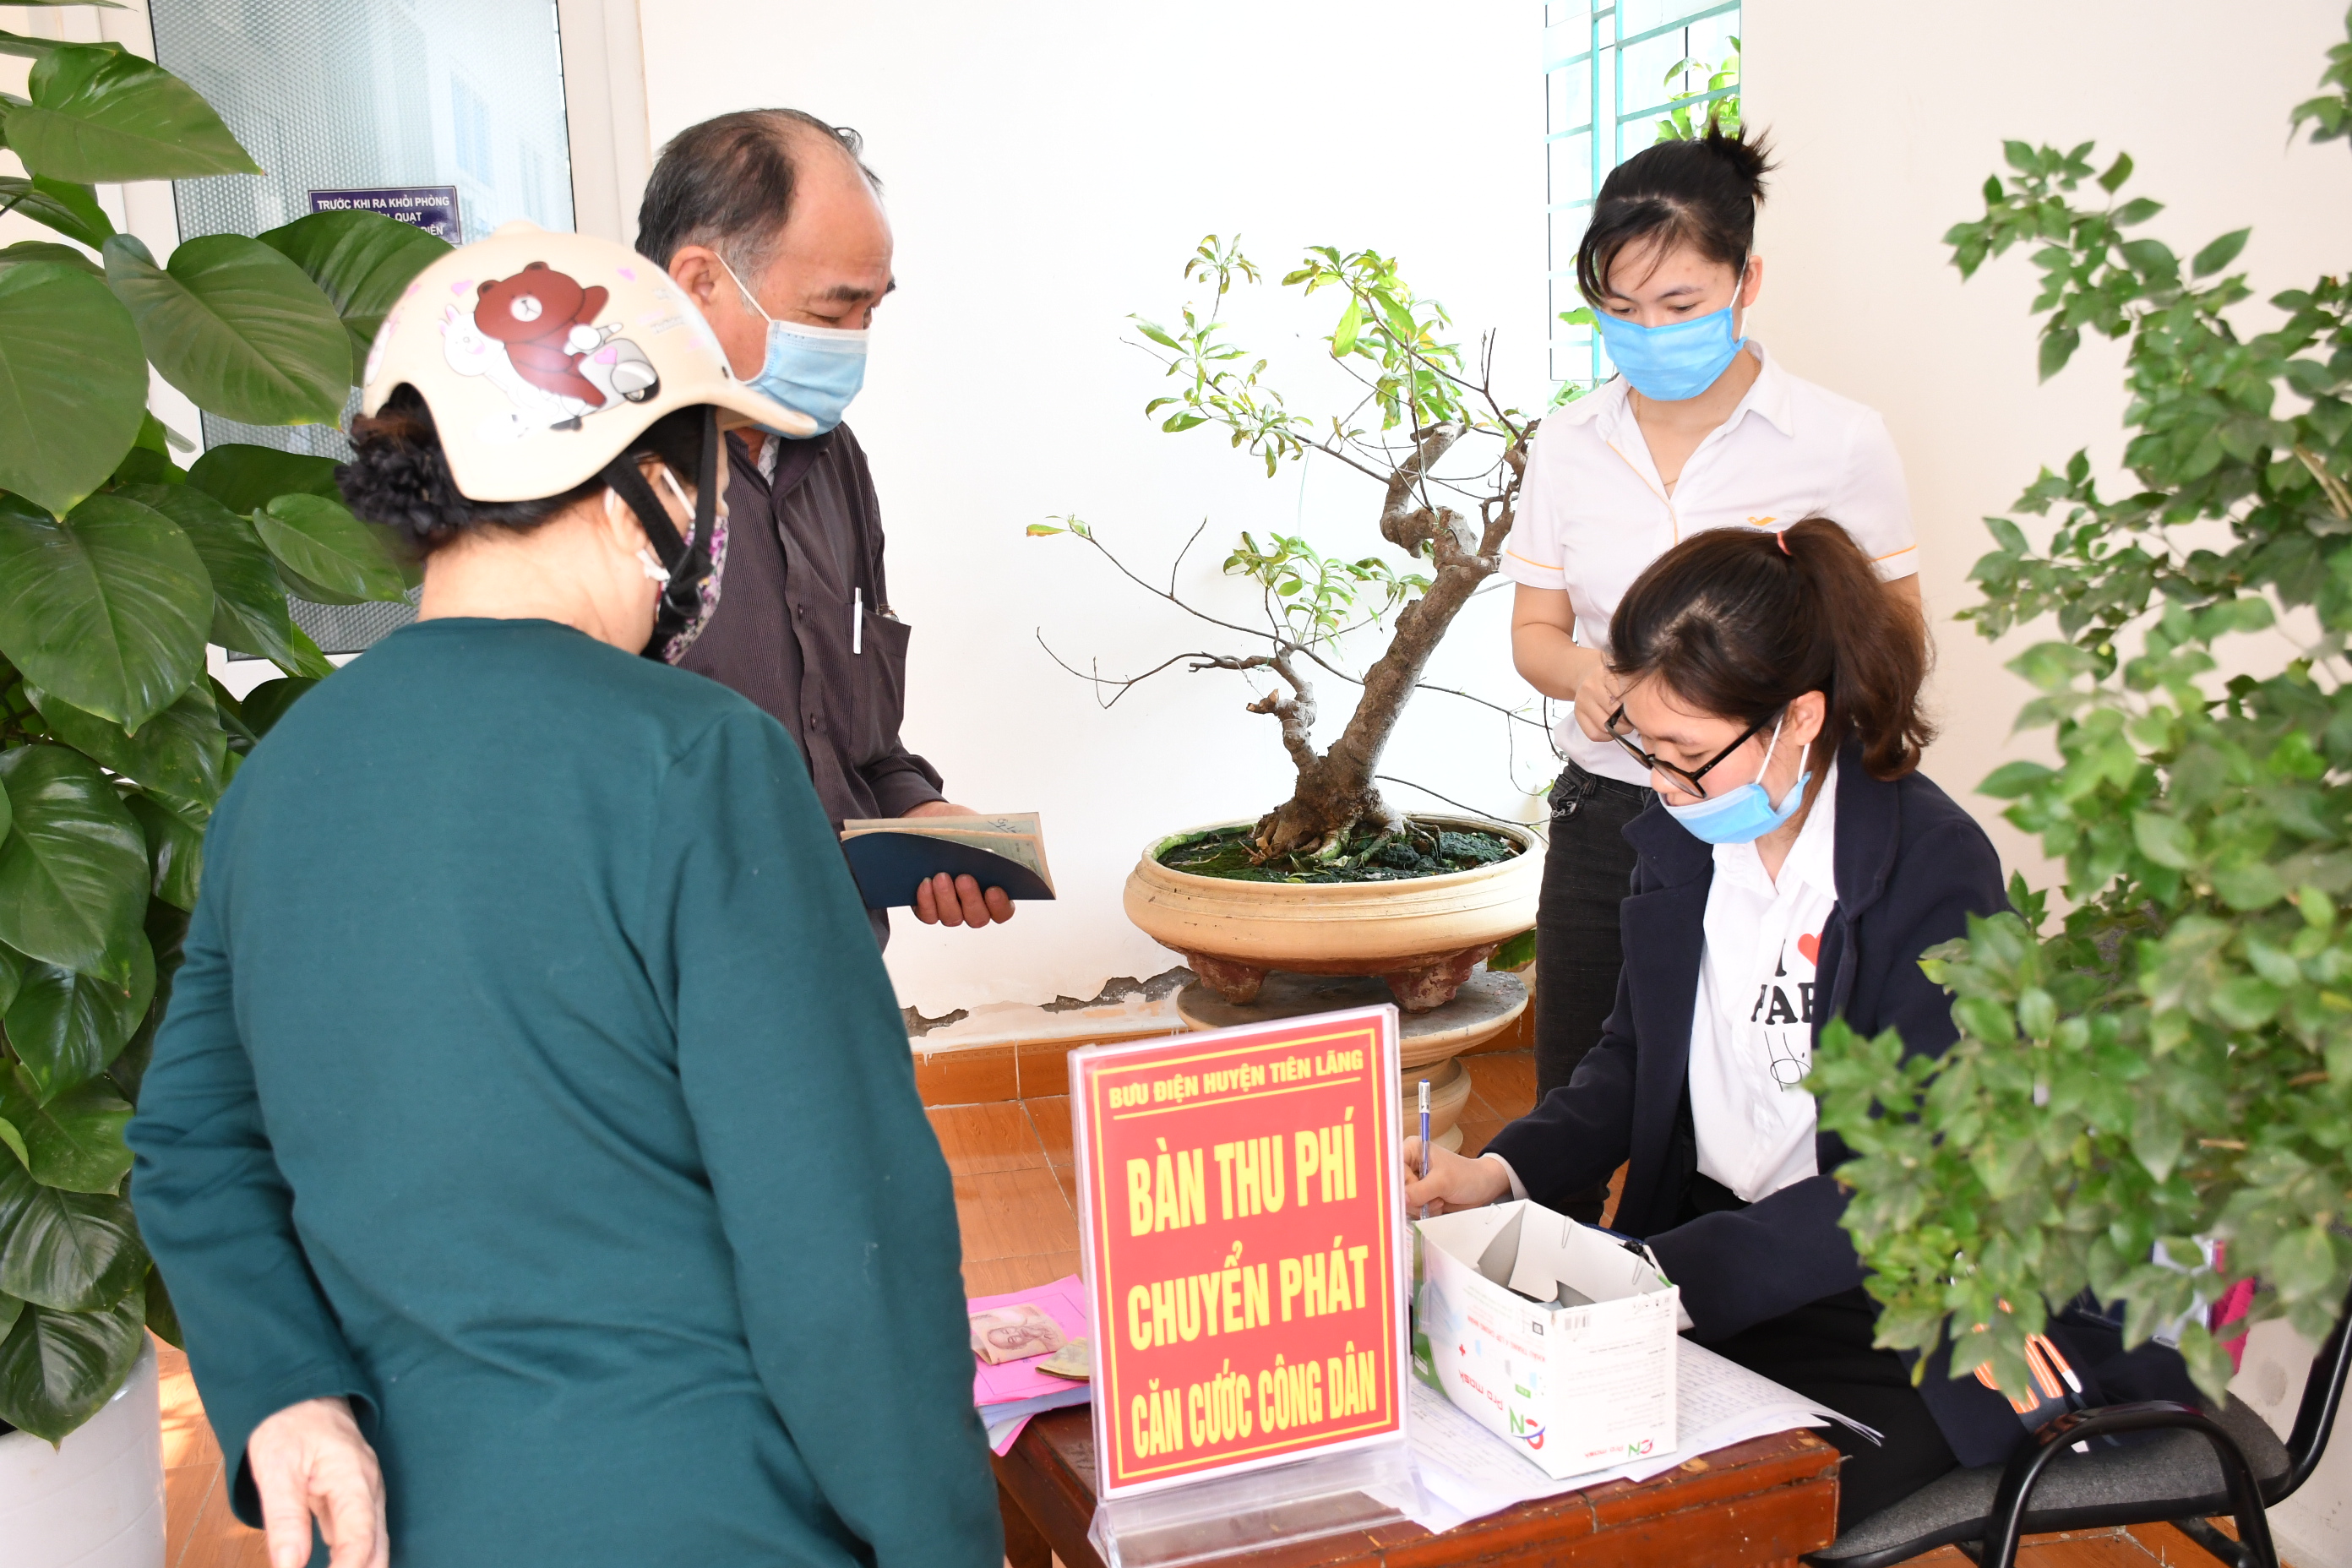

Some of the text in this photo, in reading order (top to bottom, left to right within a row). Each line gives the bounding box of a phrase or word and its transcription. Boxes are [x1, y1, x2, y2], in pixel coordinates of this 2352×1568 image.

[317, 194, 449, 210] TRƯỚC KHI RA KHỎI PHÒNG
[395, 211, 422, 224] QUẠT
[1108, 1049, 1364, 1109] BƯU ĐIỆN HUYỆN TIÊN LÃNG
[1126, 1106, 1357, 1237] BÀN THU PHÍ
[1127, 1235, 1369, 1351] CHUYỂN PHÁT
[1131, 1341, 1376, 1459] CĂN CƯỚC CÔNG DÂN
[1458, 1369, 1484, 1395] mask
[1486, 1390, 1504, 1412] Pro
